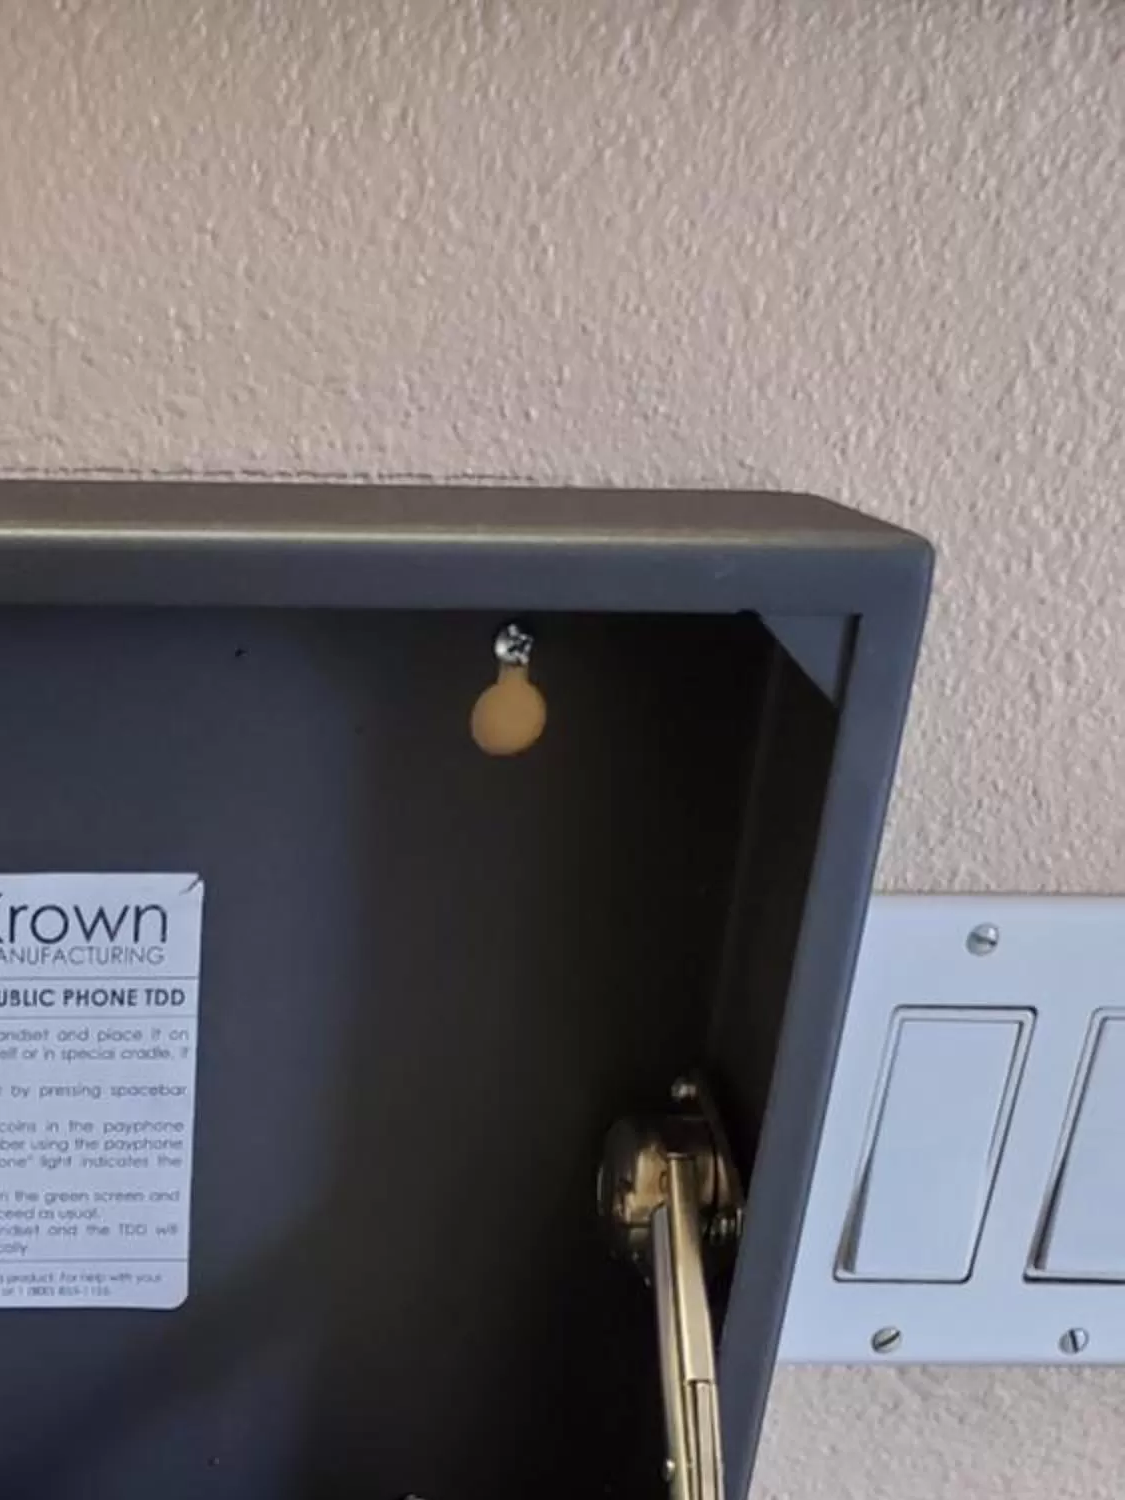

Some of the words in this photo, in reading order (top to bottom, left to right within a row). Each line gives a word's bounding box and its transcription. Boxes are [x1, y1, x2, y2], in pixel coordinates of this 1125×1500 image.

[63, 989, 137, 1007] PHONE
[145, 989, 186, 1007] TDD
[57, 1029, 89, 1043] and
[97, 1029, 143, 1046] place
[169, 1029, 189, 1043] on
[22, 1049, 41, 1060] or
[61, 1047, 115, 1064] special
[11, 1085, 29, 1100] by
[39, 1085, 100, 1101] pressing
[110, 1085, 187, 1101] spacebar
[45, 1120, 59, 1133] in
[69, 1120, 93, 1133] the
[103, 1120, 184, 1136] payphone
[30, 1139, 69, 1154] using
[75, 1138, 100, 1151] the
[104, 1138, 183, 1154] payphone
[40, 1156, 71, 1171] light
[80, 1156, 148, 1168] indicates
[158, 1156, 182, 1168] the
[15, 1191, 39, 1202] the
[44, 1191, 91, 1205] green
[93, 1191, 143, 1202] screen
[146, 1191, 179, 1202] and
[48, 1224, 77, 1236] and
[86, 1224, 109, 1236] the
[155, 1224, 178, 1236] will
